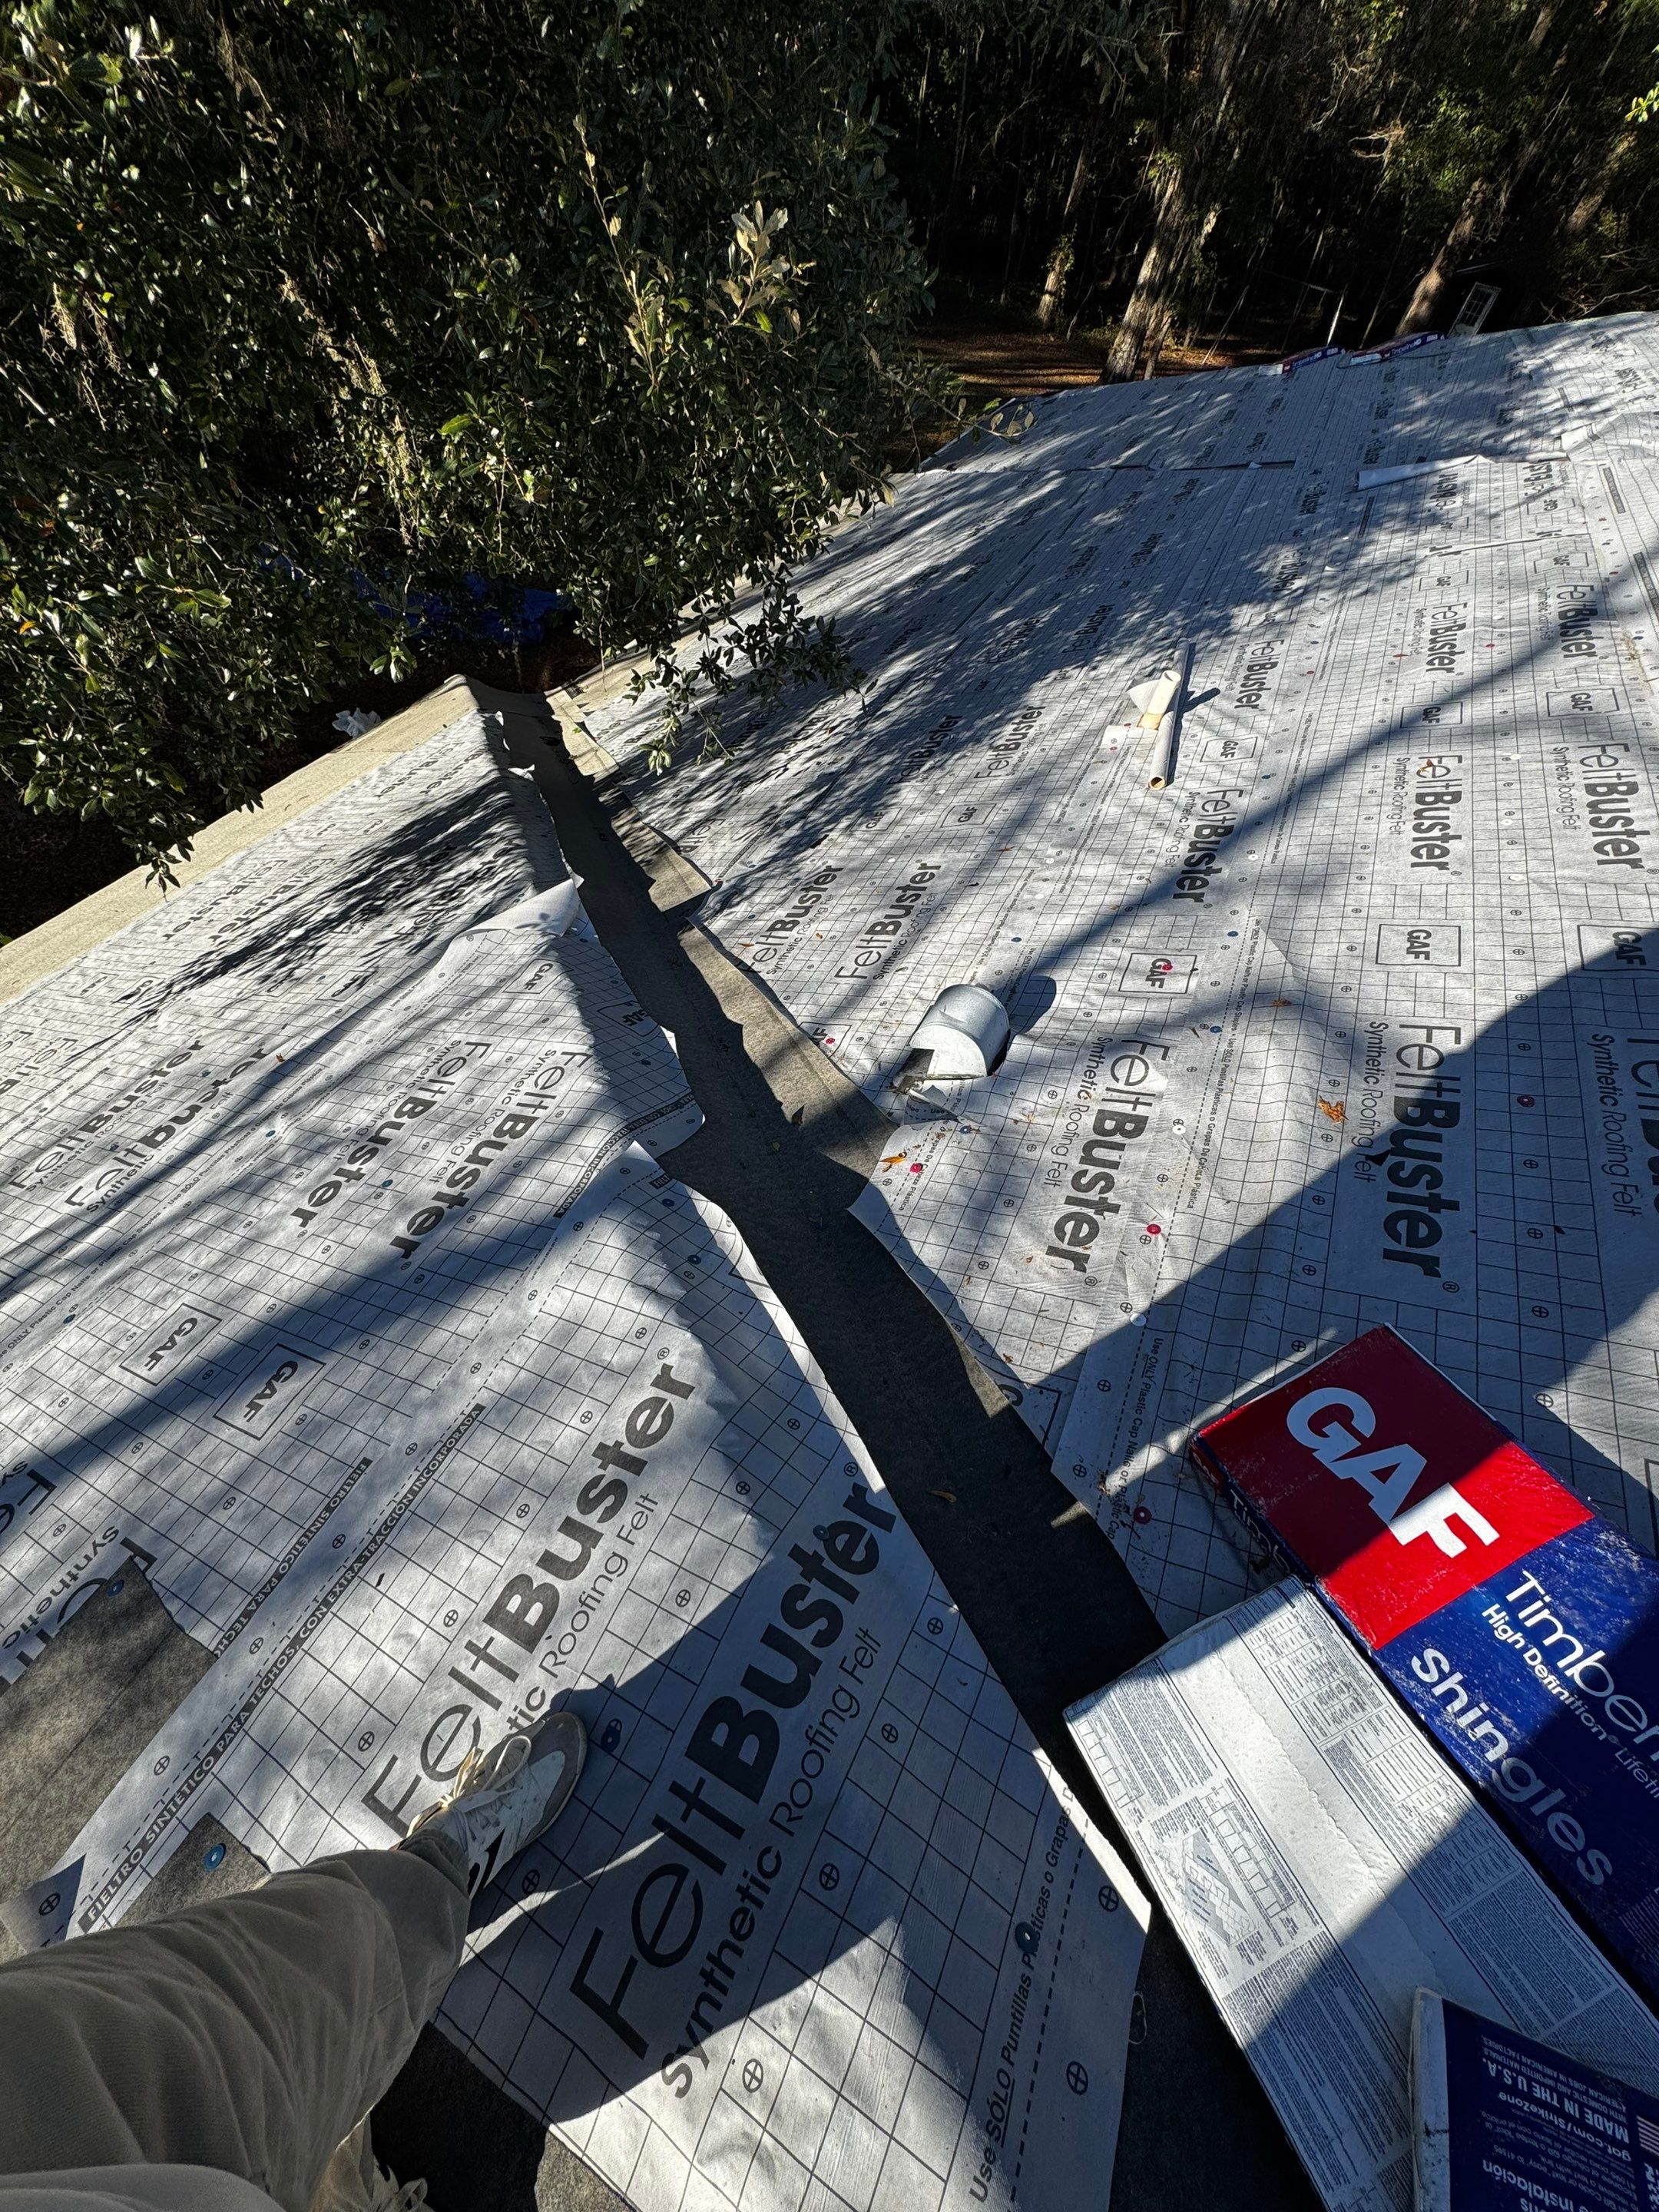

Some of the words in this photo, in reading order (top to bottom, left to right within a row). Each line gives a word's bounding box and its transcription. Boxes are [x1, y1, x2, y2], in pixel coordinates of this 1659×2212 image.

[1426, 602, 1468, 674] FeltBuster
[1556, 584, 1604, 658] FeltBuster
[1234, 639, 1285, 710] FeltBuster
[1422, 707, 1442, 724] GAF
[1571, 693, 1593, 712] GAF
[888, 714, 963, 785] FeltBuster
[974, 705, 1045, 779] FeltBuster
[1220, 740, 1239, 759] GAF
[1552, 747, 1571, 783] Synthetic
[1393, 757, 1411, 793] Synthetic
[1555, 782, 1575, 814] Roofing
[866, 812, 885, 829] GAF
[957, 806, 979, 823] GAF
[1179, 792, 1200, 823] Synthetic
[1386, 790, 1409, 820] Roofing
[1389, 821, 1406, 835] Felt
[1410, 754, 1462, 871] FeltBuster
[1562, 814, 1581, 830] Felt
[1578, 743, 1651, 869] FeltBuster
[1172, 789, 1244, 902] FeltBuster
[163, 859, 287, 940] FeltBuster
[209, 858, 335, 942] FeltBuster
[739, 865, 843, 972] FeltBuster
[835, 863, 942, 979] FeltBuster
[767, 935, 803, 975] Synthetic
[802, 906, 829, 935] Roofing
[873, 938, 907, 980] Synthetic
[902, 906, 927, 939] Roofing
[1406, 929, 1432, 960] GAF
[1612, 931, 1647, 966] GAF
[525, 963, 554, 991] GAF
[1148, 957, 1174, 988] GAF
[399, 1038, 461, 1088] Synthetic
[503, 1049, 557, 1104] Synthetic
[1077, 1037, 1113, 1101] Synthetic
[1216, 1063, 1229, 1087] Puntillas
[1363, 1021, 1389, 1086] Synthetic
[1591, 1033, 1619, 1108] Synthetic
[9, 1039, 205, 1189] FeltBuster
[355, 1091, 406, 1137] Roofing
[1209, 1087, 1224, 1116] Plásticas
[1352, 1088, 1383, 1150] Roofing
[290, 1040, 492, 1228] FeltBuster
[332, 1139, 358, 1161] Felt
[450, 1107, 505, 1156] Roofing
[1051, 1103, 1090, 1157] Roofing
[1200, 1121, 1216, 1147] Grapas
[1200, 1147, 1209, 1157] De
[1383, 1024, 1461, 1278] FeltBuster
[1601, 1110, 1627, 1179] Roofing
[389, 1050, 594, 1260] FeltBuster
[429, 1158, 457, 1184] Felt
[1043, 1161, 1068, 1188] Felt
[1045, 1038, 1171, 1274] FeltBuster
[1194, 1157, 1207, 1181] Cabeza
[86, 1154, 154, 1214] Synthetic
[556, 1156, 601, 1215] INCORPORADA
[1186, 1181, 1201, 1210] Plástica
[1611, 1182, 1642, 1216] Felt
[6, 1327, 31, 1350] ONLY
[28, 1303, 57, 1330] Plastic
[55, 1290, 73, 1307] Cap
[70, 1273, 91, 1293] Nails
[90, 1265, 100, 1275] or
[98, 1243, 124, 1268] Plastic
[121, 1232, 137, 1247] Cap
[136, 1210, 162, 1234] Staples
[167, 1191, 182, 1206] Use
[144, 1316, 198, 1372] GAF
[1142, 1355, 1158, 1381] ONLY
[1150, 1336, 1164, 1355] Use
[244, 1360, 298, 1423] GAF
[1134, 1381, 1152, 1416] Plastic
[1128, 1415, 1144, 1439] Cap
[1119, 1470, 1130, 1483] or
[1123, 1441, 1138, 1468] Nails
[1286, 1386, 1500, 1559] GAF
[327, 1462, 368, 1510] FIELTRO
[276, 1508, 331, 1575] SINTÉTICO
[1107, 1520, 1120, 1540] Cap
[3, 1525, 121, 1650] Synthetic
[246, 1575, 279, 1614] PARA
[360, 1363, 696, 1839] FeltBuster
[538, 1553, 630, 1681] Roofing
[615, 1492, 661, 1548] Felt
[83, 1845, 147, 1922] FIELTRO
[141, 1752, 217, 1844] SINTÉTICO
[214, 1708, 252, 1753] PARA
[247, 1641, 301, 1706] TECHOS,
[297, 1604, 328, 1640] CON
[323, 1490, 417, 1604] EXTRA-TRACCIÓN
[409, 1406, 482, 1494] INCORPORADA
[1481, 1602, 1525, 1649] High
[1522, 1644, 1608, 1741] Definition
[569, 1481, 898, 2061] FeltBuster
[1411, 1647, 1614, 1886] Shingles
[1042, 1803, 1076, 1869] Grapas
[660, 1843, 783, 2100] Synthetic
[769, 1687, 863, 1837] Roofing
[839, 1627, 883, 1687] Felt
[1043, 1869, 1055, 1883] o
[995, 1971, 1037, 2068] Puntillas
[1482, 2056, 1528, 2094] U.S.A.
[1521, 2054, 1557, 2080] AMERICAN
[1521, 2063, 1555, 2088] IMPORTED
[1556, 2081, 1571, 2096] AND
[977, 2067, 1018, 2143] SÓLO
[1531, 2079, 1560, 2108] THE
[1563, 2096, 1579, 2119] IN
[1572, 2088, 1607, 2115] DOMESTIC
[1498, 2089, 1631, 2164] gaf.com/StrikeZone
[1516, 2121, 1531, 2135] con
[1583, 2105, 1629, 2144] MADE
[967, 2145, 998, 2204] Use
[1482, 2157, 1573, 2212] instalación
[1588, 2157, 1608, 2175] para
